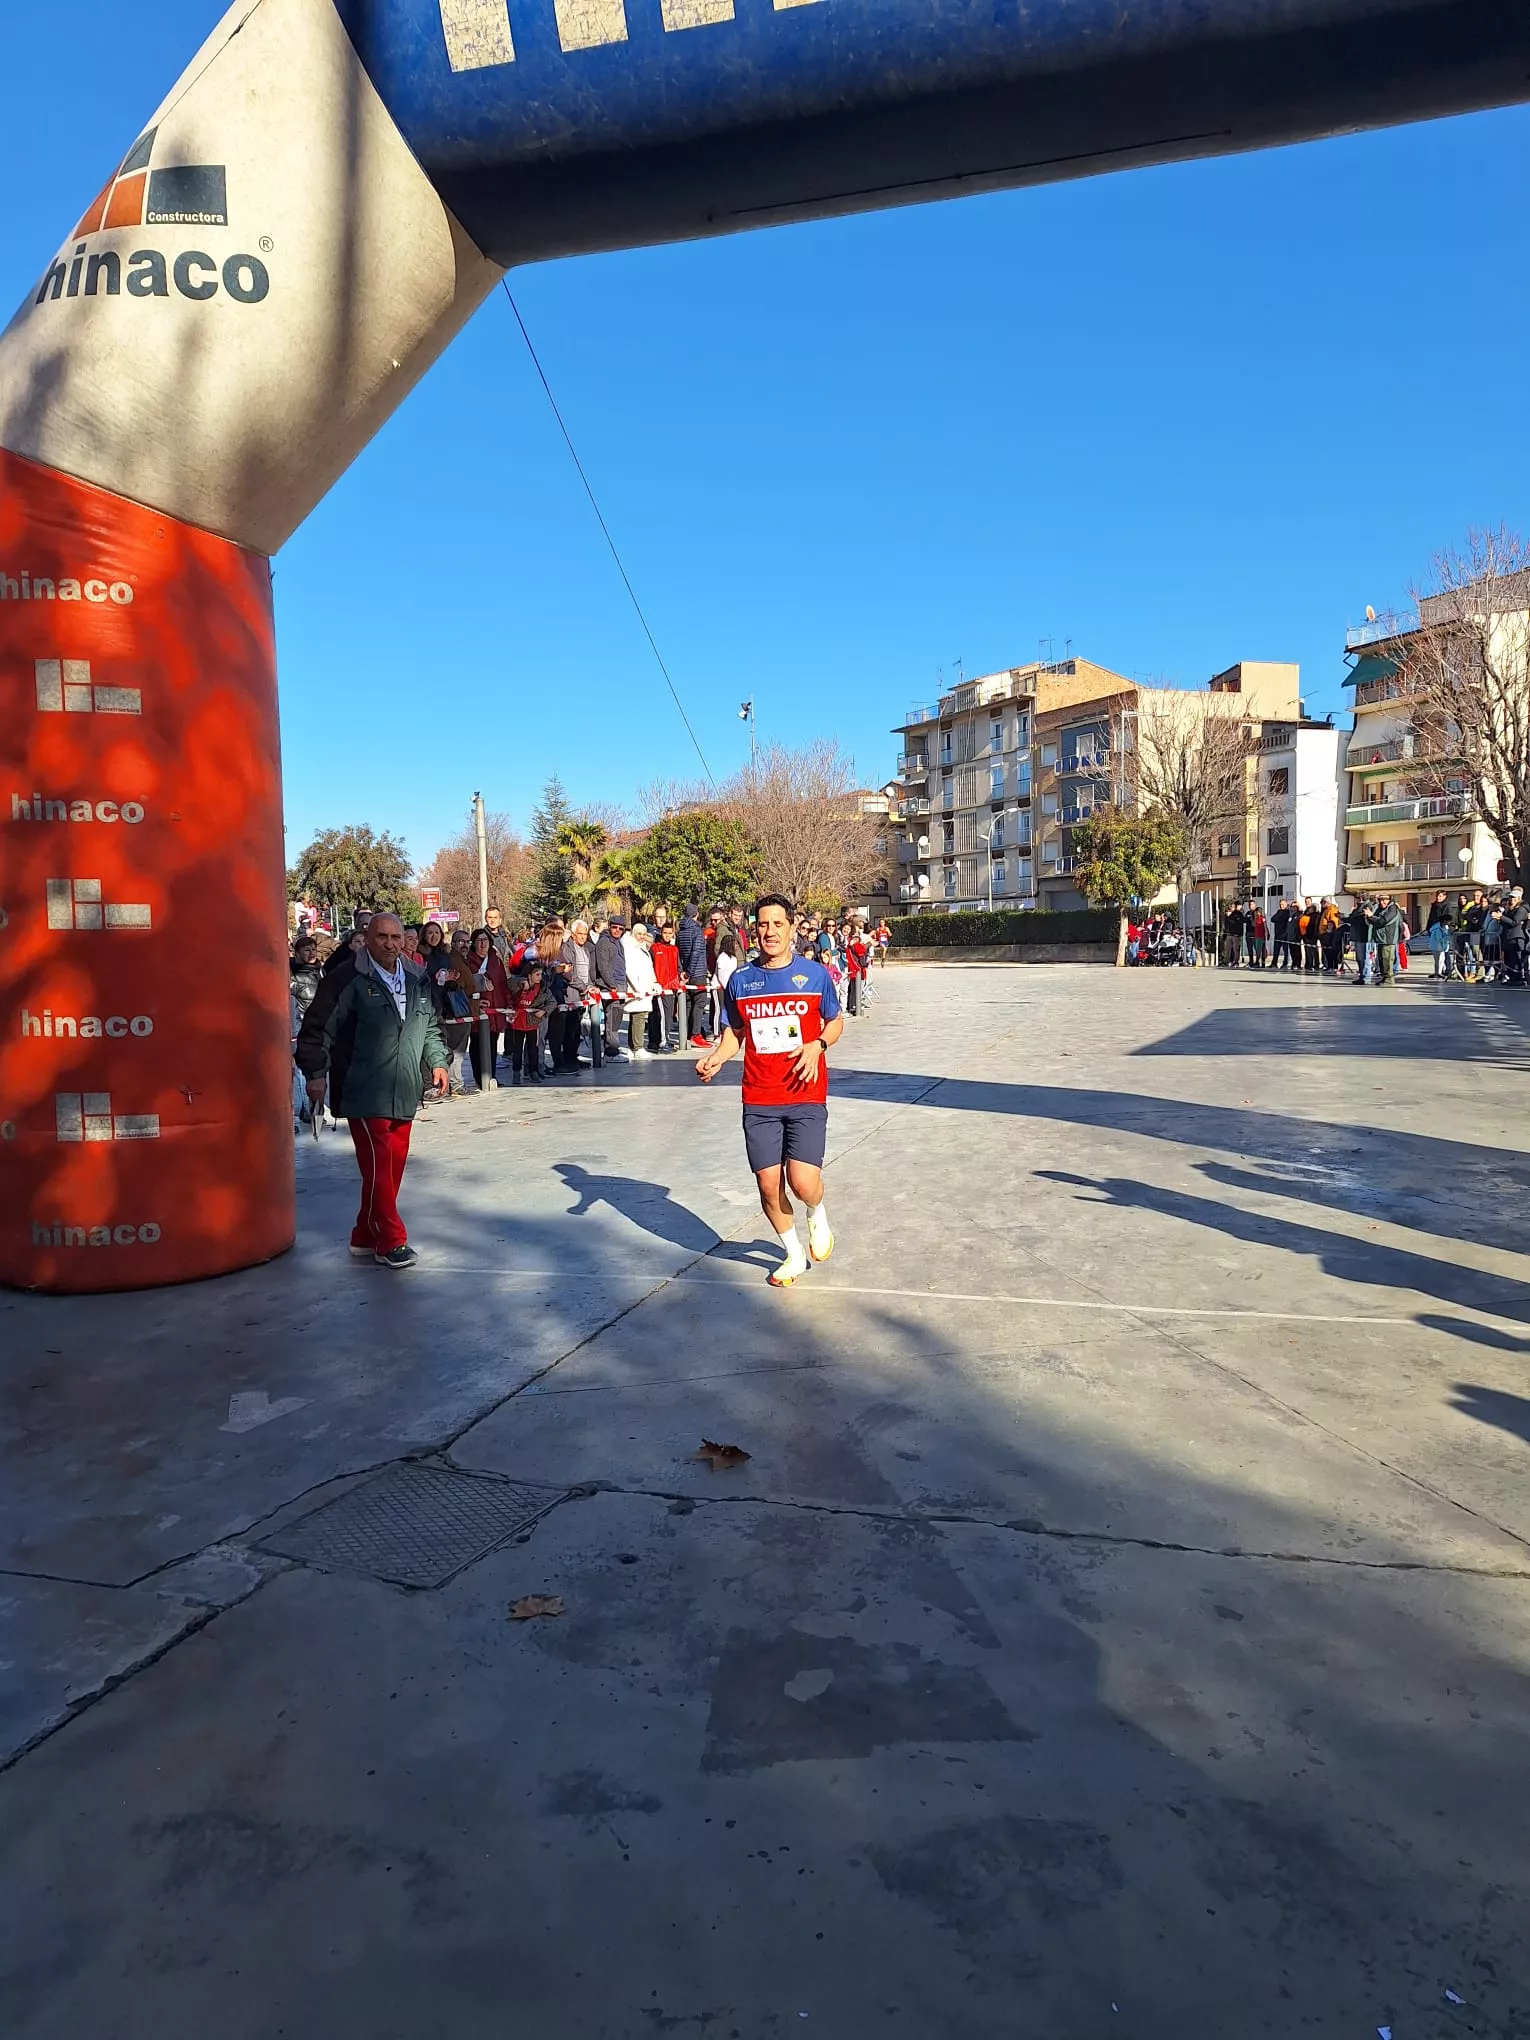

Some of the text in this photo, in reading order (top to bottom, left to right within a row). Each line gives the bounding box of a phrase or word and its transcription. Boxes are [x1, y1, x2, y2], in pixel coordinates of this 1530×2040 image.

[147, 210, 225, 224] Constructora
[36, 242, 270, 304] hinaco
[0, 570, 134, 605] hinaco
[11, 792, 145, 824] hinaco
[21, 1008, 154, 1038] hinaco
[31, 1218, 162, 1247] hinaco
